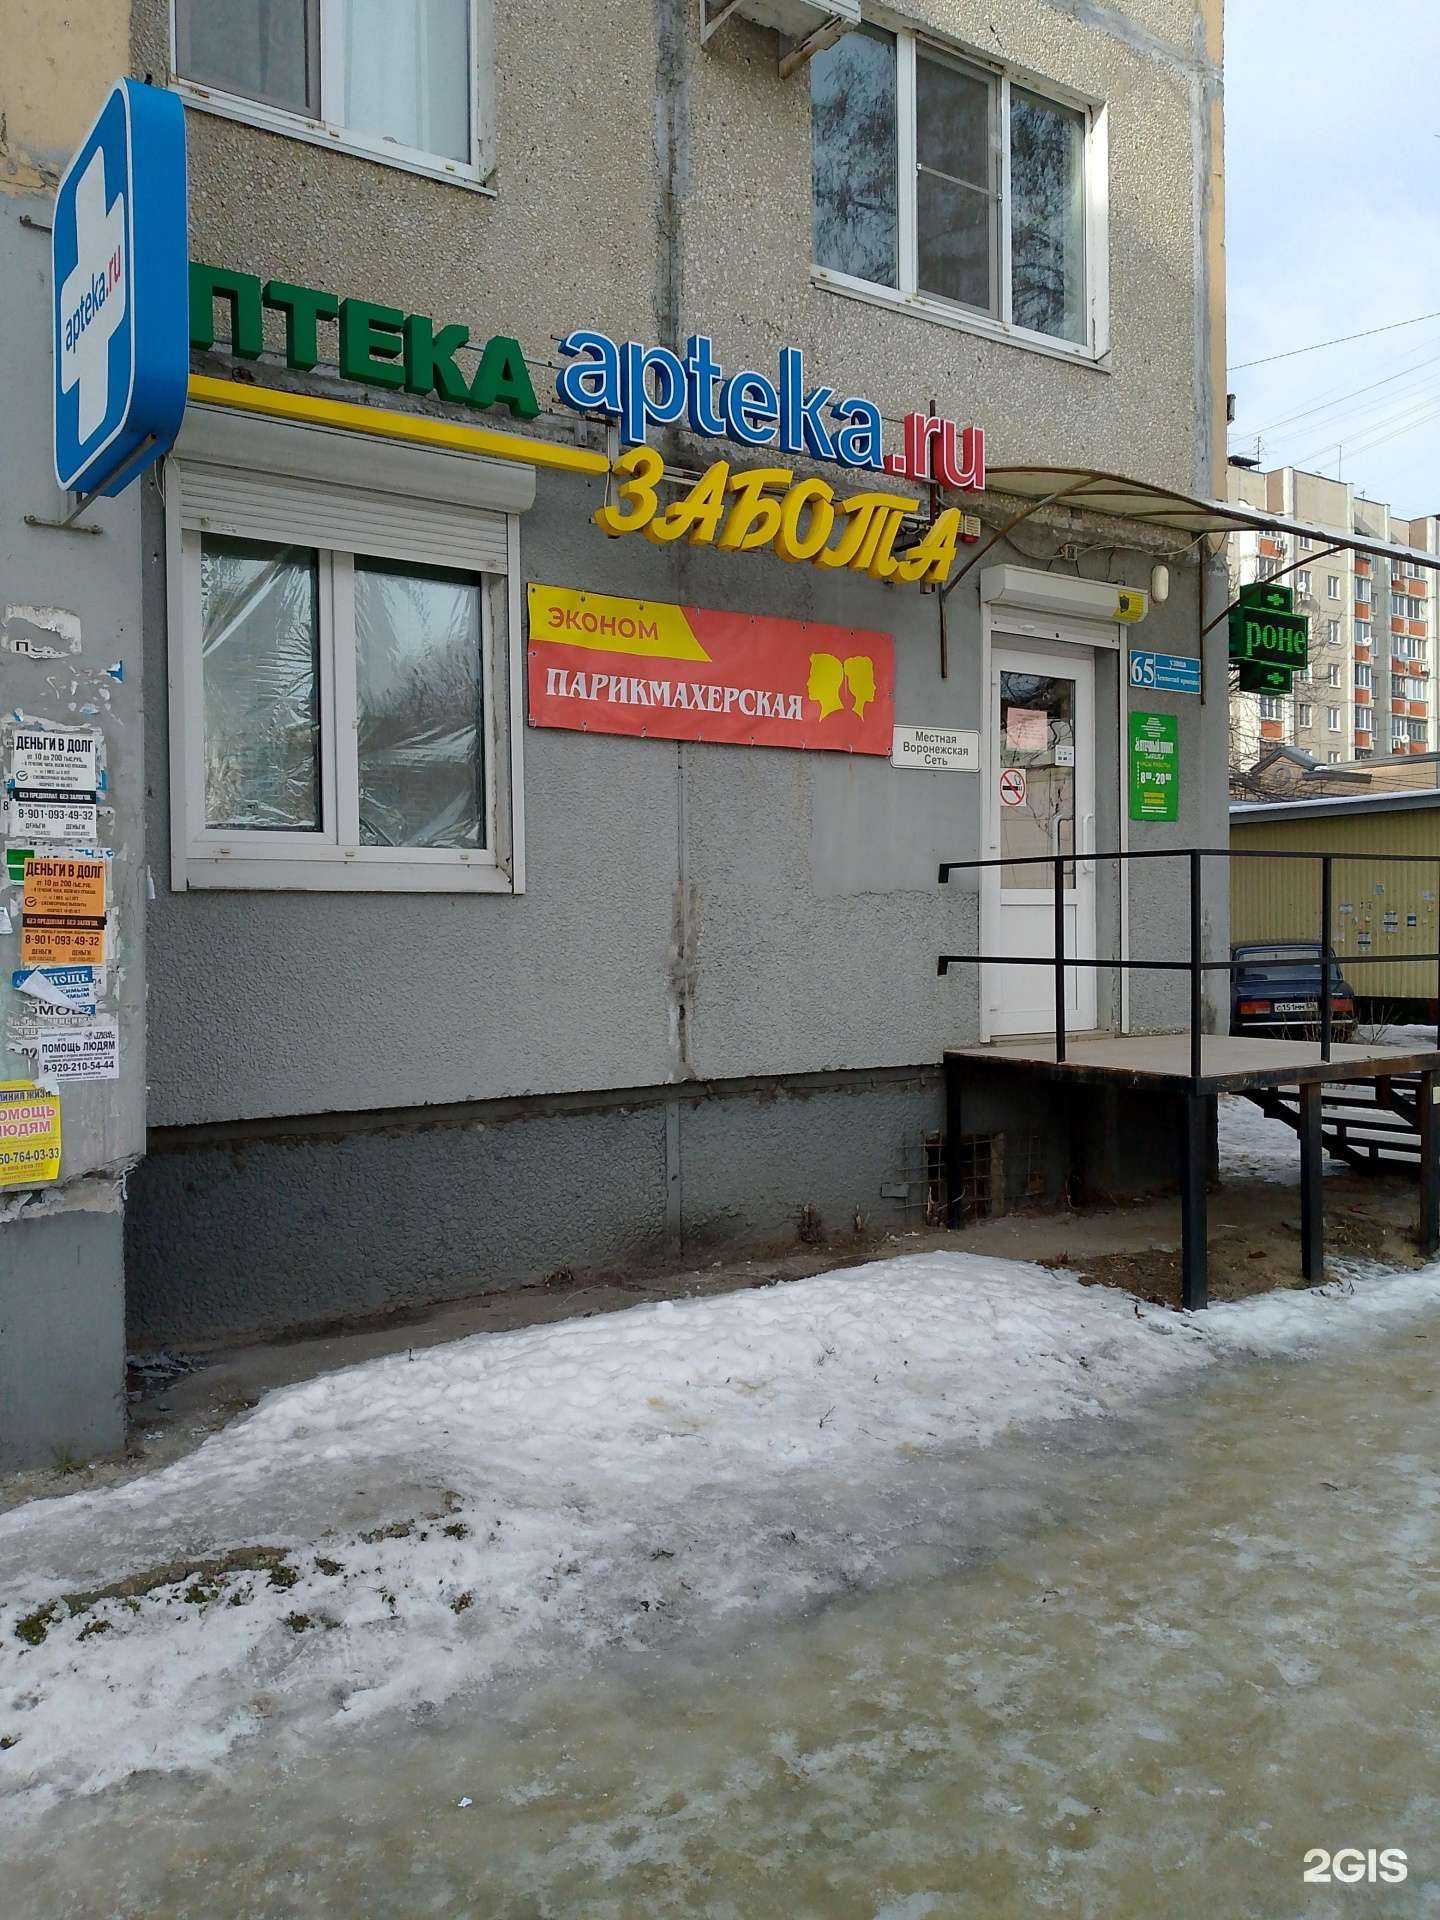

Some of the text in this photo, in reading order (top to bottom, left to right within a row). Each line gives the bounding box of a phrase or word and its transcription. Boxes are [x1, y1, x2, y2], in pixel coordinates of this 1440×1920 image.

[65, 244, 121, 354] apteka.ru
[556, 330, 986, 491] apteka.ru
[595, 446, 961, 583] ЗАБОТА
[547, 606, 659, 641] ЭКОНОМ
[1132, 657, 1154, 684] 65
[545, 667, 804, 721] ПАРИКМАХЕРСКАЯ
[16, 736, 93, 753] ДЕНЬГИ В ДОЛГ
[915, 730, 957, 744] Местная
[903, 741, 969, 756] Воронежская
[924, 753, 948, 766] Сеть
[18, 809, 93, 821] 8-901-093-49-32
[26, 862, 103, 879] ДЕНЬГИ В ДОЛГ
[25, 934, 99, 946] 8-901-093-49-32
[42, 1043, 80, 1053] ПОМОЩЬ
[83, 1040, 115, 1052] ЛЮДЯМ
[0, 1120, 51, 1137] ЮДЯМ
